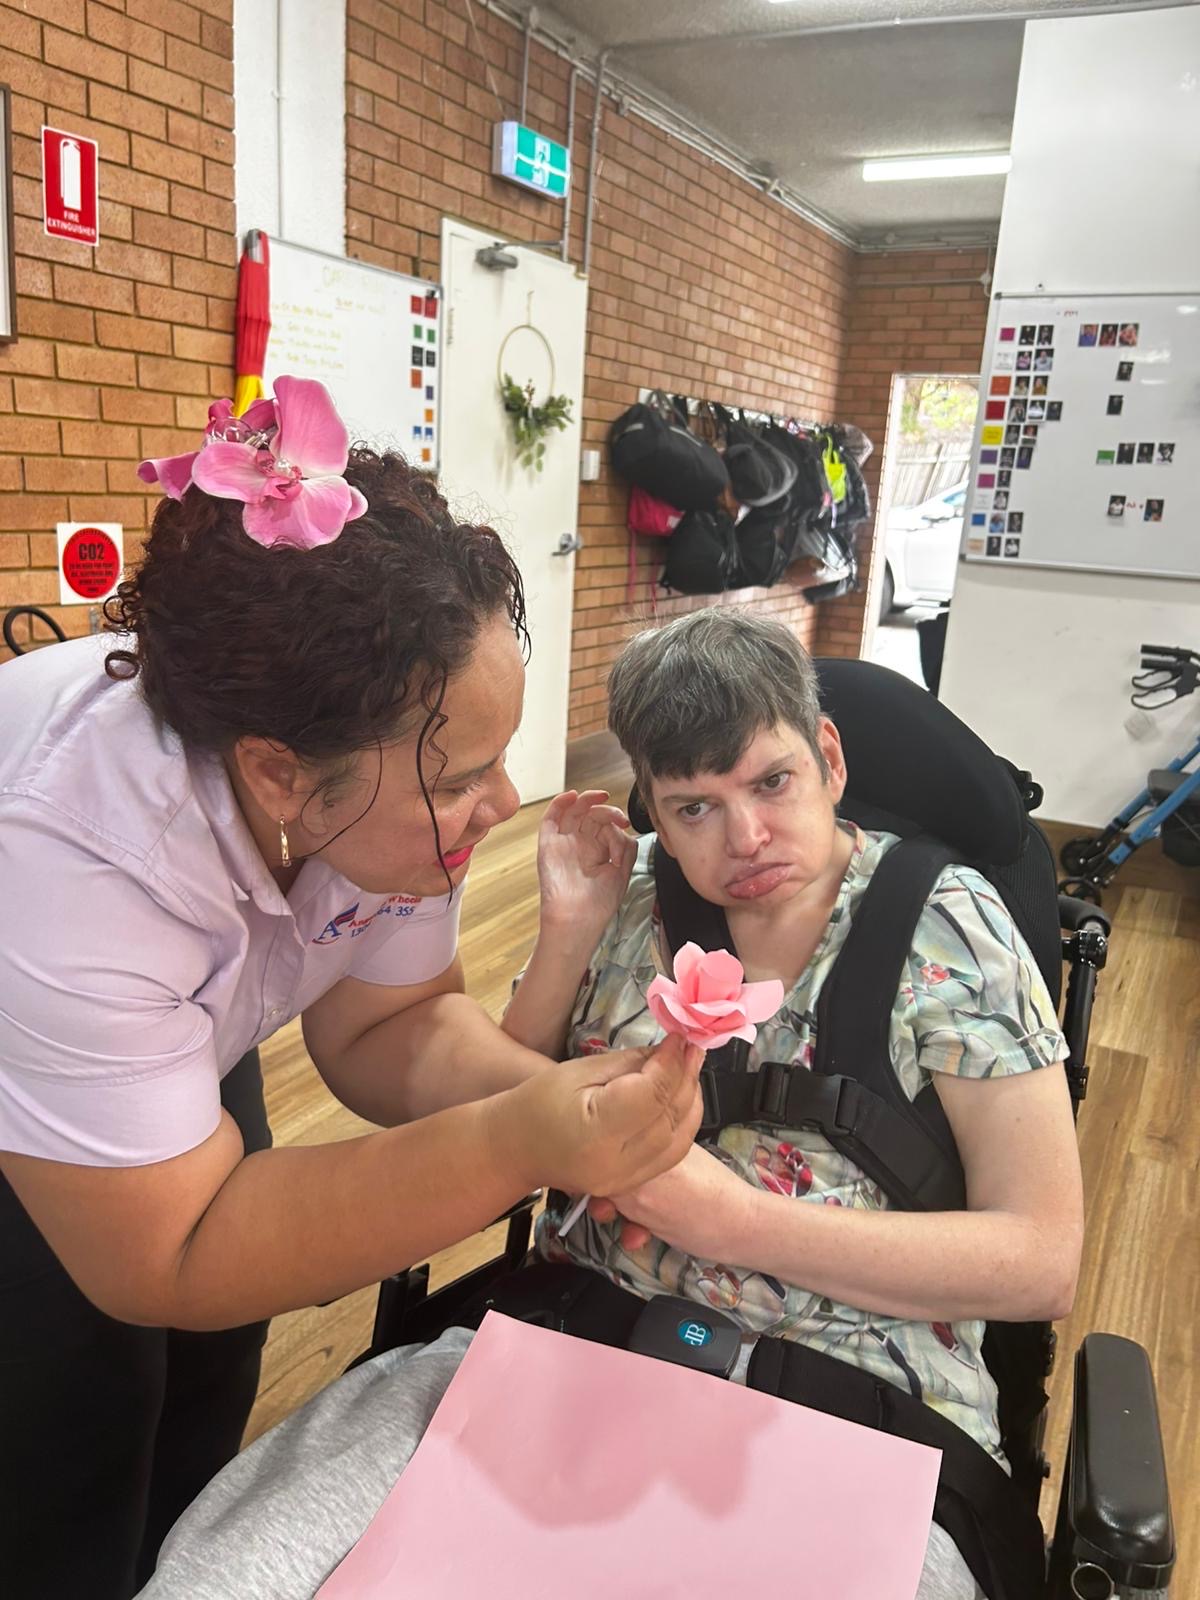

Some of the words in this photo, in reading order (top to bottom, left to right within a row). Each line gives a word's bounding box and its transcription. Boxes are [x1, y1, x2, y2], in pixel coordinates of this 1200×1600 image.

[64, 210, 79, 222] FIRE
[48, 217, 95, 236] EXTINGUISHER
[395, 906, 415, 917] 355
